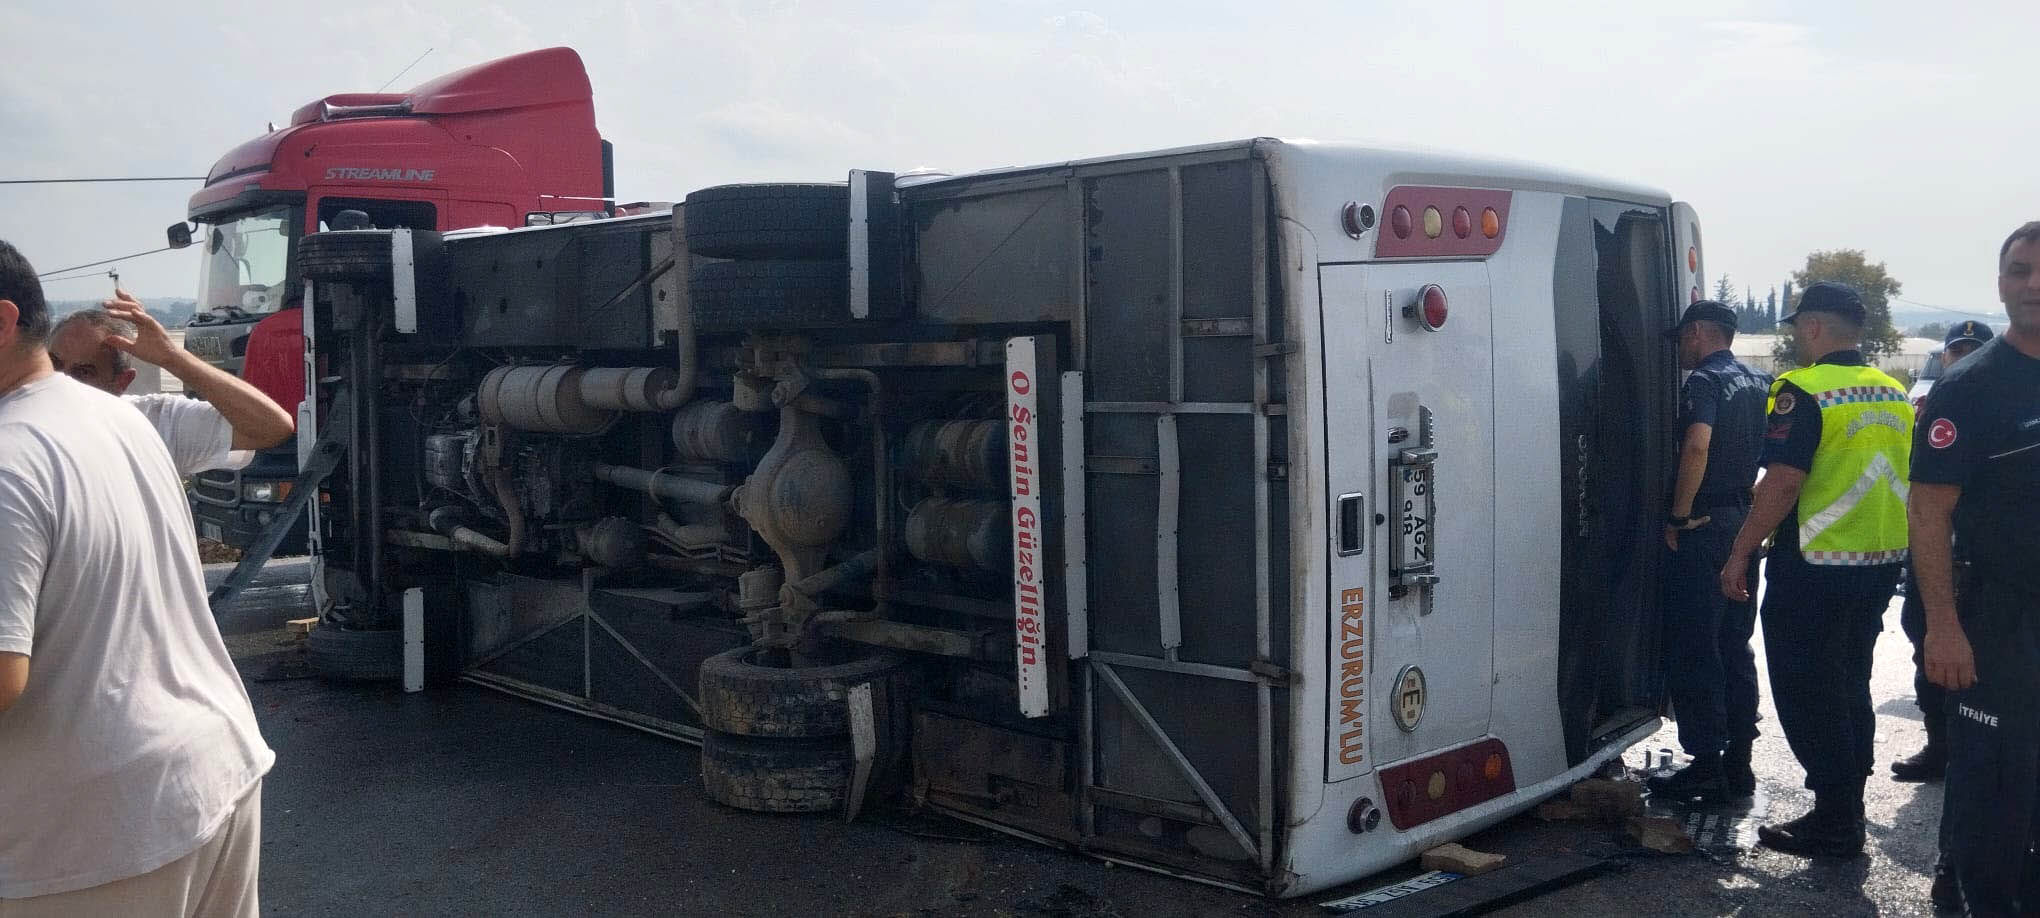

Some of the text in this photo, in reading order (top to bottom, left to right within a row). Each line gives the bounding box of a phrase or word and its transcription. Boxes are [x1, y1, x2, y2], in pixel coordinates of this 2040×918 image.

[325, 167, 436, 181] STREAMLINE
[1011, 370, 1041, 691] O Senin Güzelliğin...
[1403, 499, 1413, 536] 918
[1413, 469, 1426, 560] 59 AGZ
[1340, 586, 1364, 766] ERZURUM'LU
